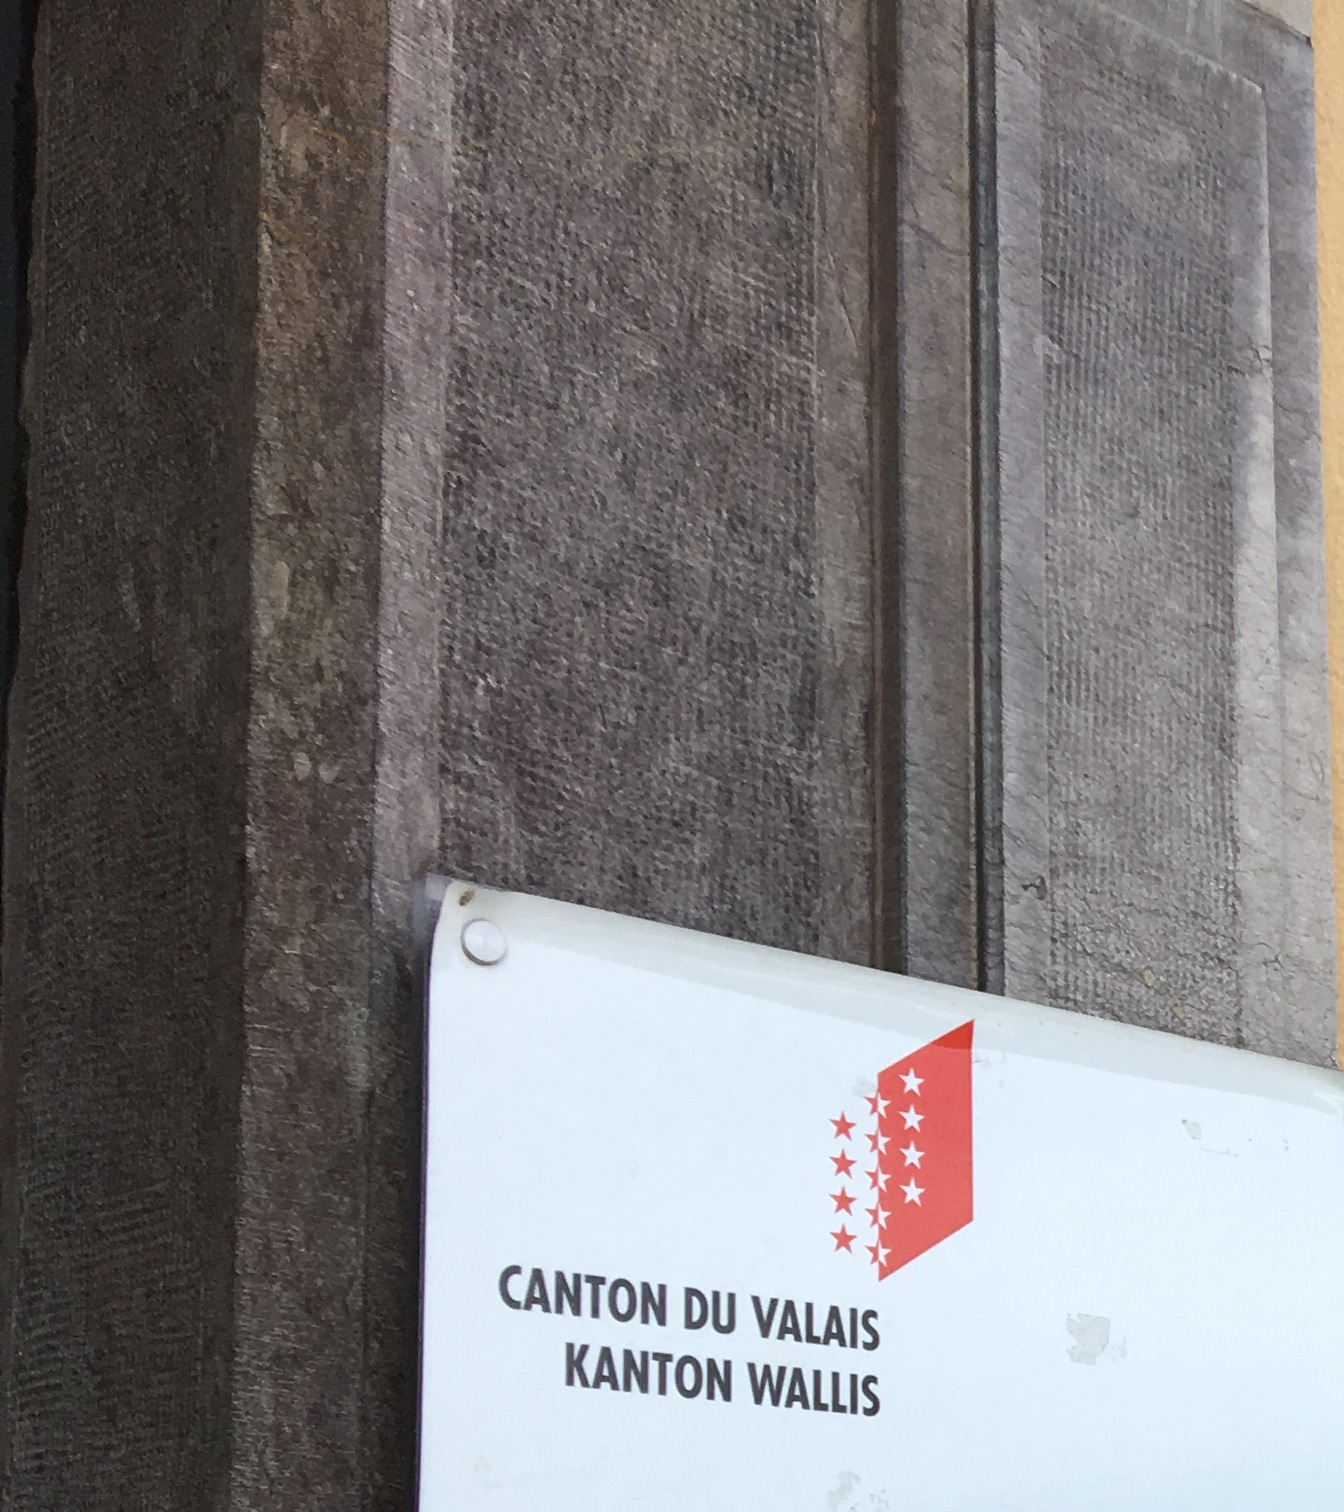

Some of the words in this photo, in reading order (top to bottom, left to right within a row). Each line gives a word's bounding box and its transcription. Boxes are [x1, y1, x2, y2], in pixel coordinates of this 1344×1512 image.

[498, 1263, 668, 1328] CANTON
[683, 1286, 737, 1336] DU
[750, 1294, 881, 1352] VALAIS
[564, 1341, 733, 1404] KANTON
[746, 1361, 882, 1418] WALLIS
